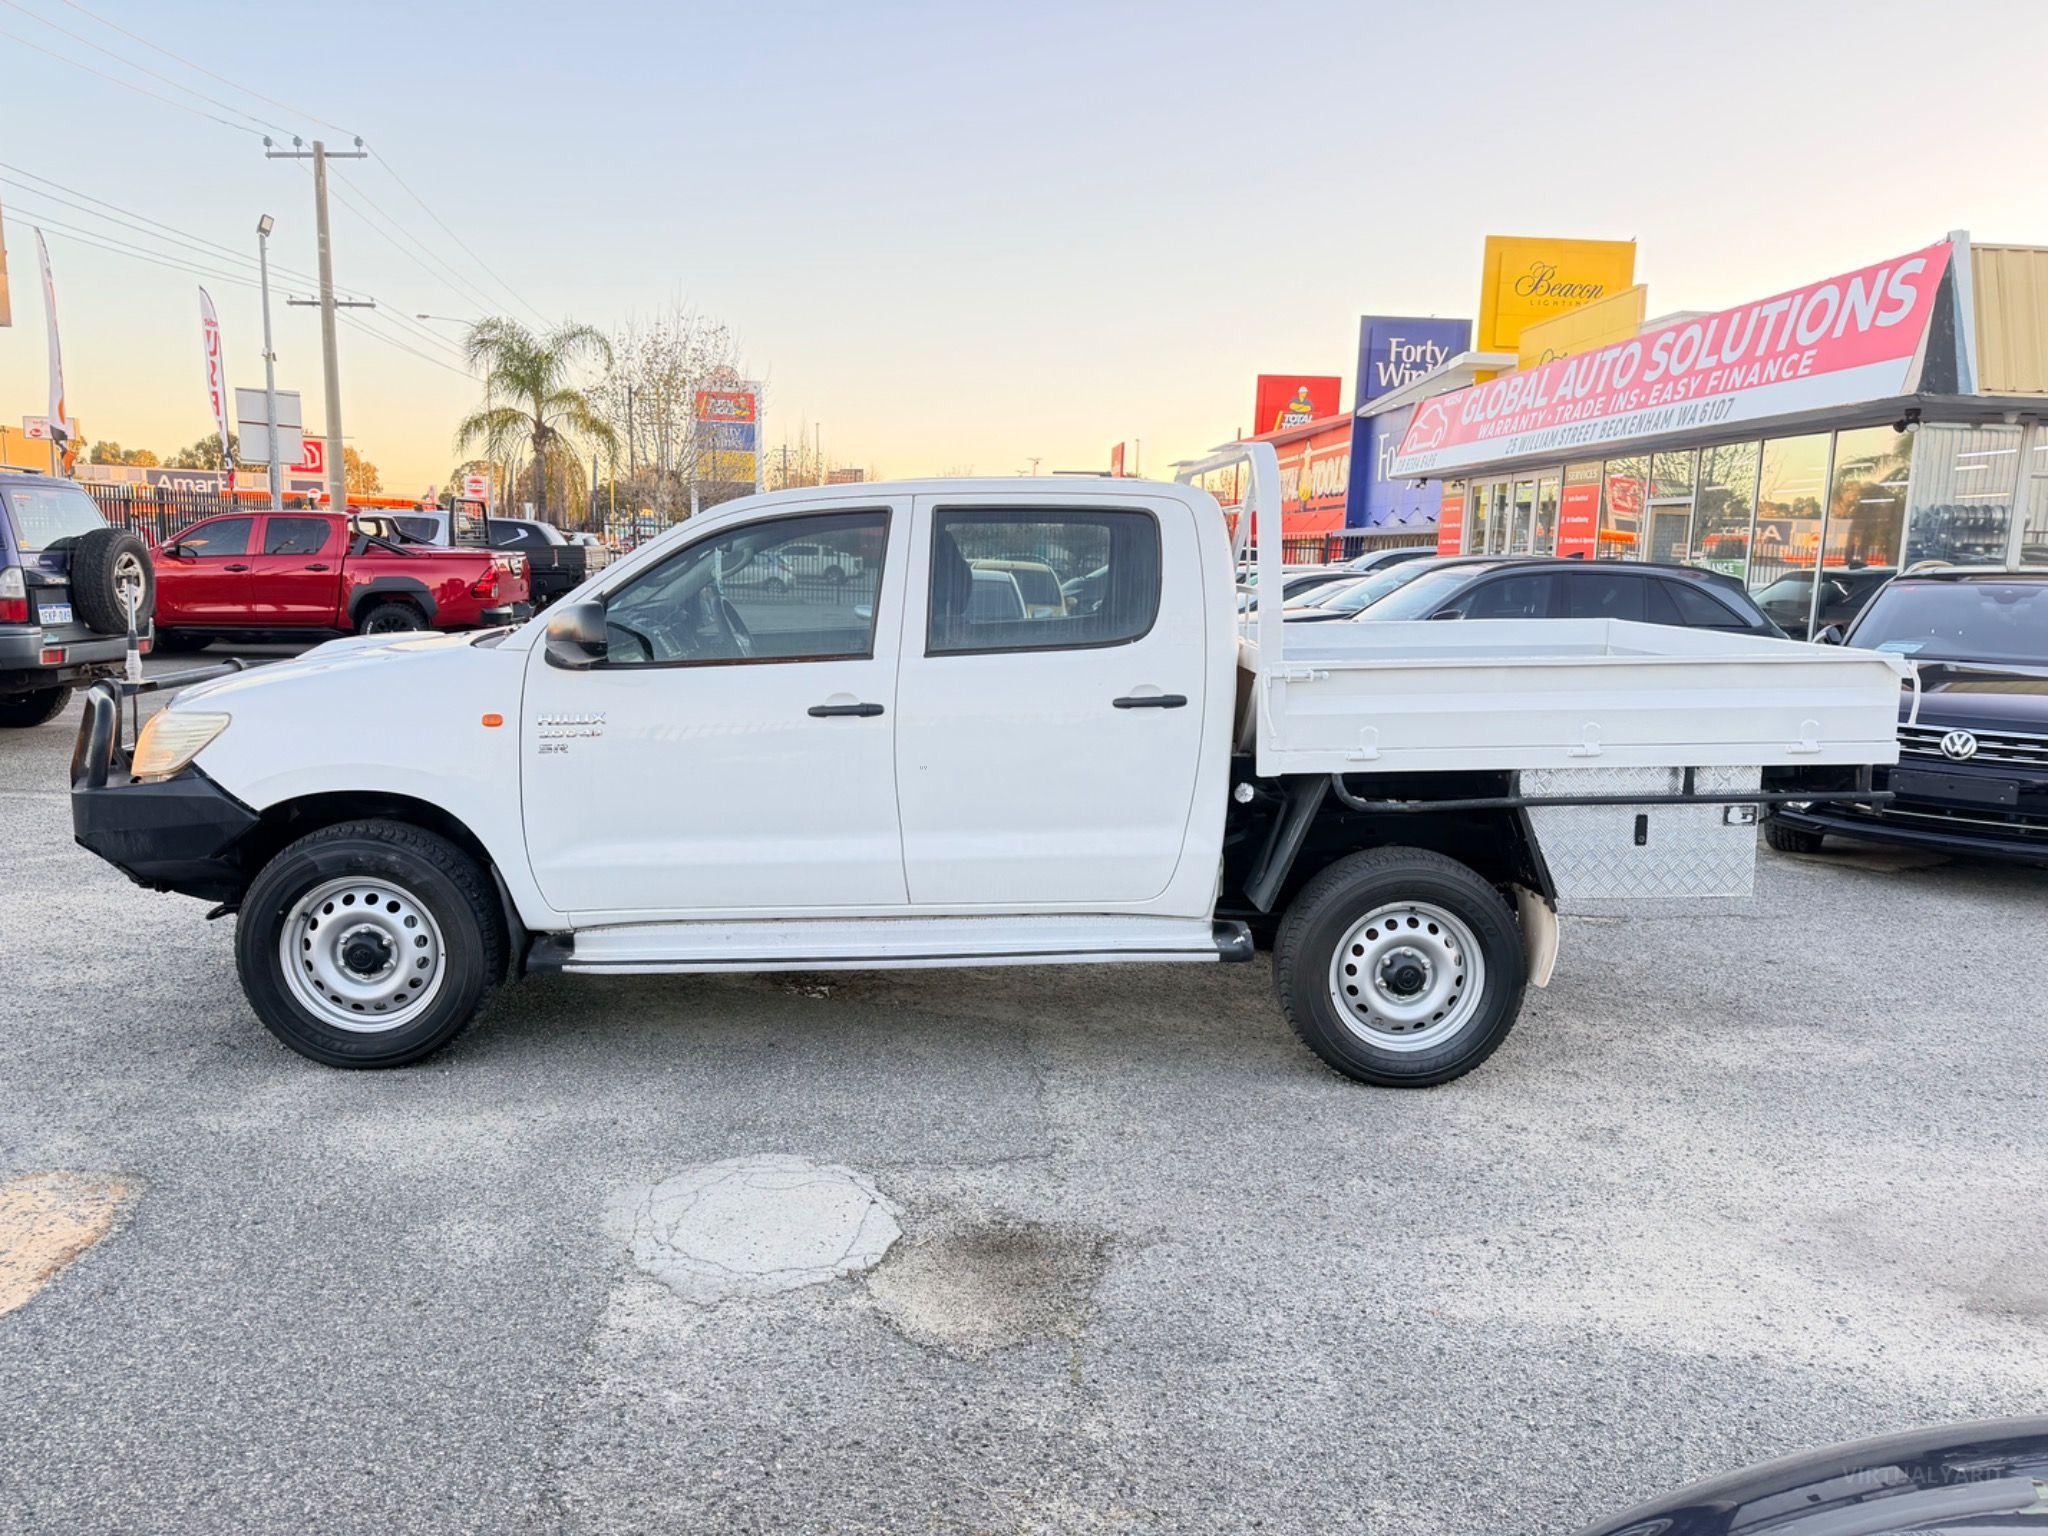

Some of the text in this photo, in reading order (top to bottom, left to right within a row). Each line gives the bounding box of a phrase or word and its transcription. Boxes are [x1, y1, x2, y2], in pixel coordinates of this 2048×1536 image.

[1515, 261, 1603, 299] Beacon
[1389, 337, 1448, 371] Forty
[1461, 258, 1927, 425] GLOBAL AUTO SOLUTIONS
[1478, 349, 1818, 438] WARRANTY TRADE INS EASY FINANCE
[1518, 430, 1559, 453] WILLIAM
[1558, 422, 1599, 446] STREET
[1599, 408, 1676, 439] BECKENHAM
[1676, 404, 1700, 427] WA
[1700, 397, 1736, 421] 6107
[158, 474, 227, 493] Amart
